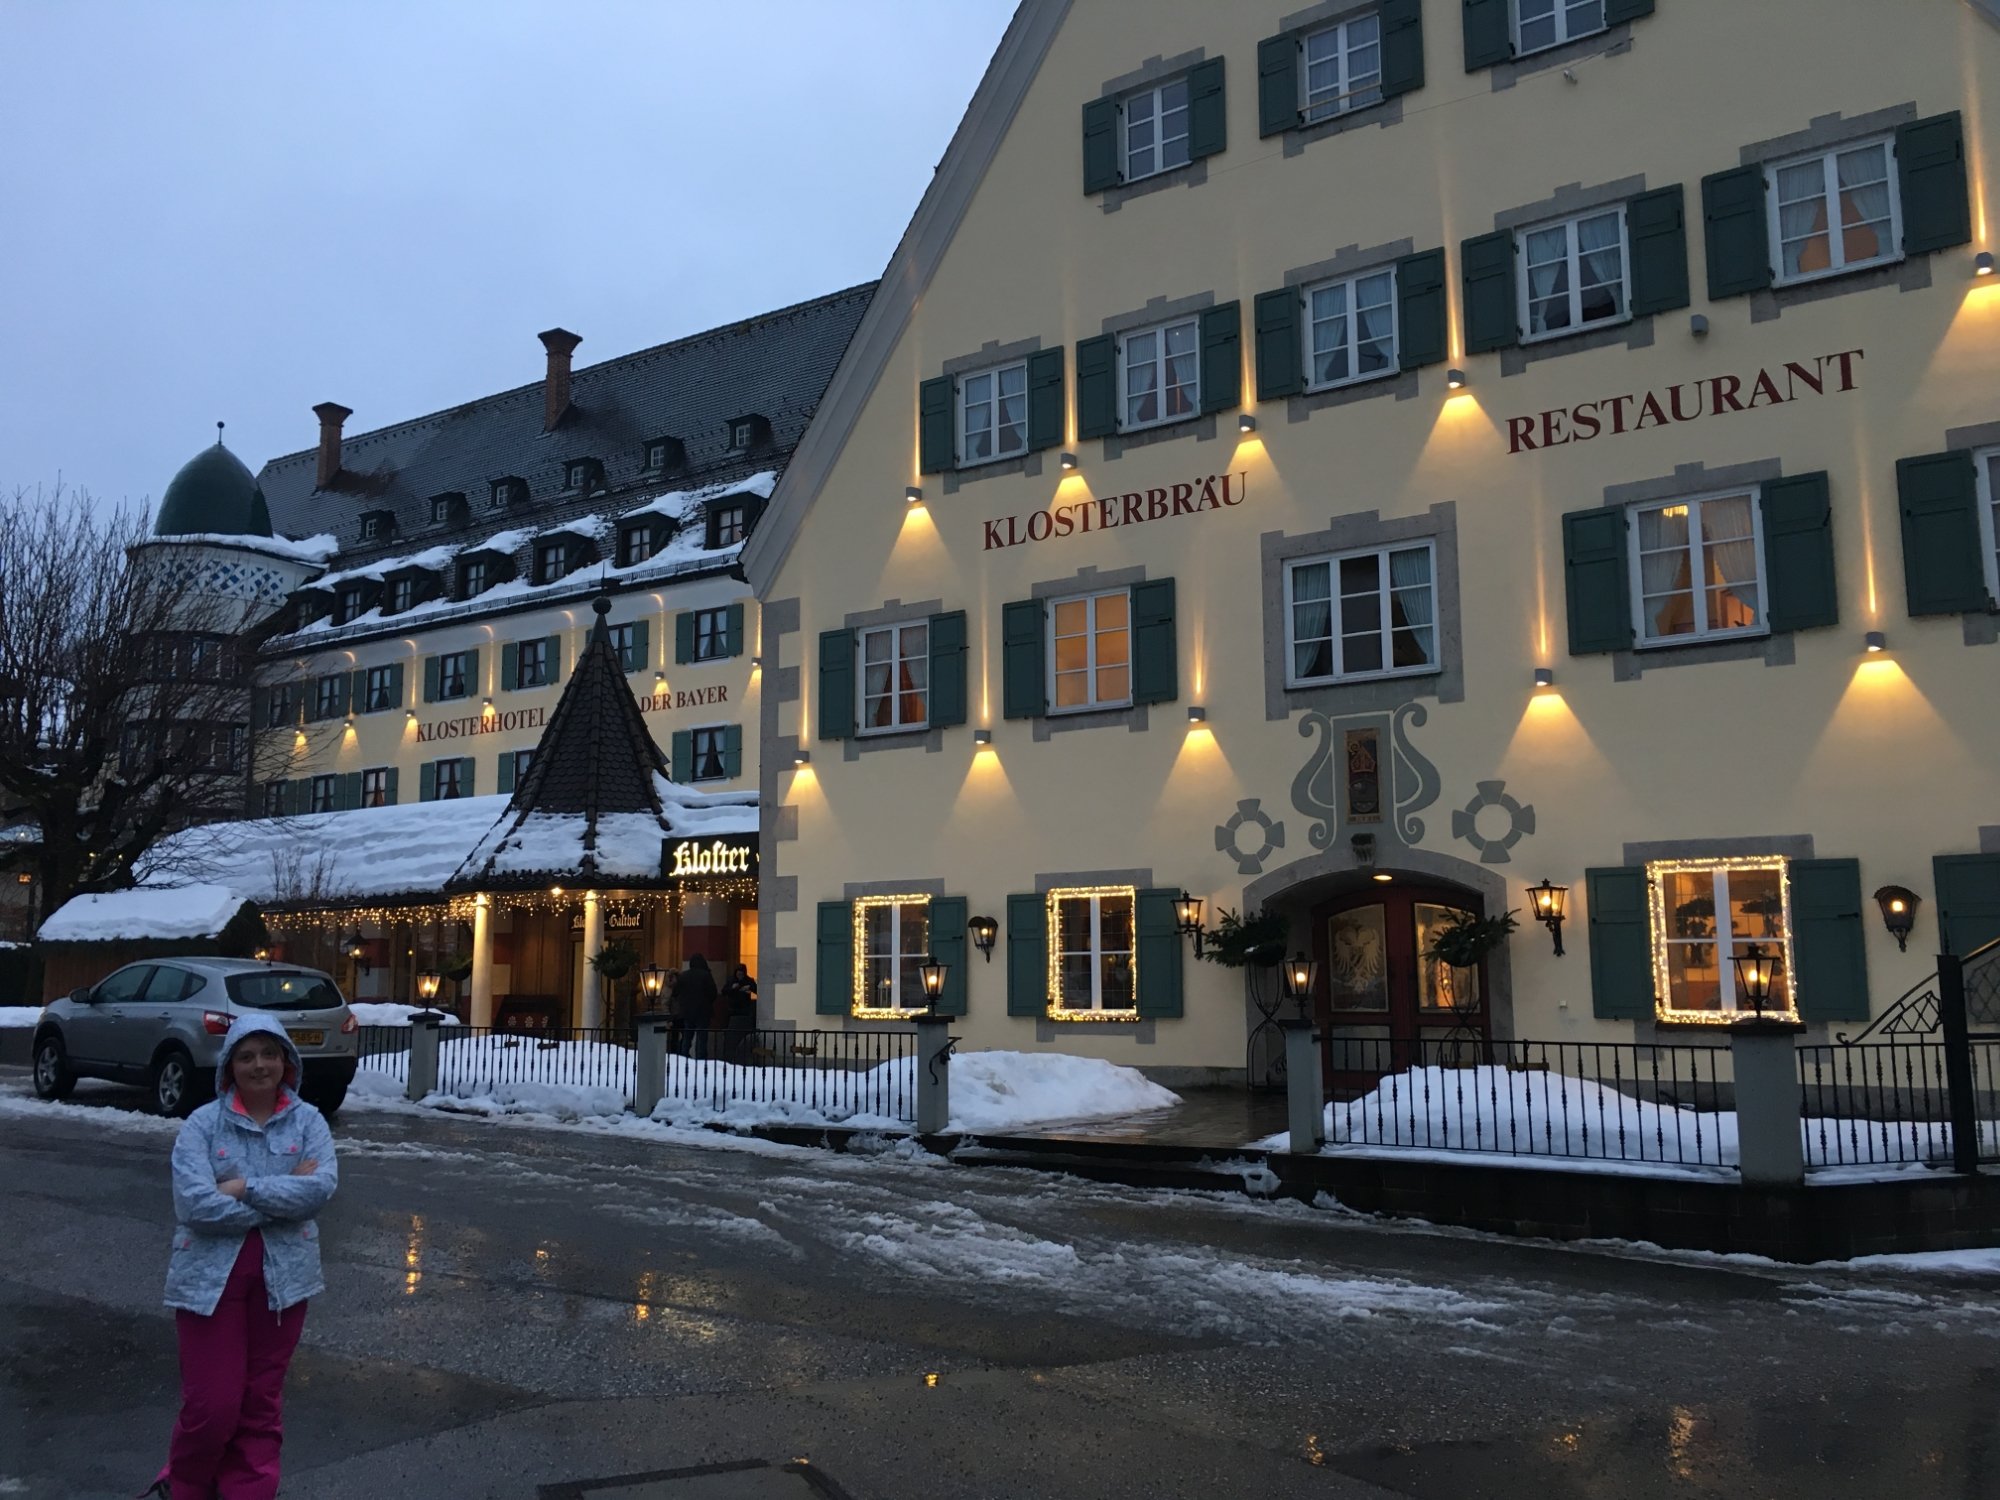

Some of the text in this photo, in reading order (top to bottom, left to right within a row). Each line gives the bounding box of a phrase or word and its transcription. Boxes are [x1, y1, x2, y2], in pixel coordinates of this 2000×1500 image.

[982, 349, 1864, 551] KLOSTERBRÄU RESTAURANT
[416, 685, 728, 743] KLOSTERHOTEL DER BAYER
